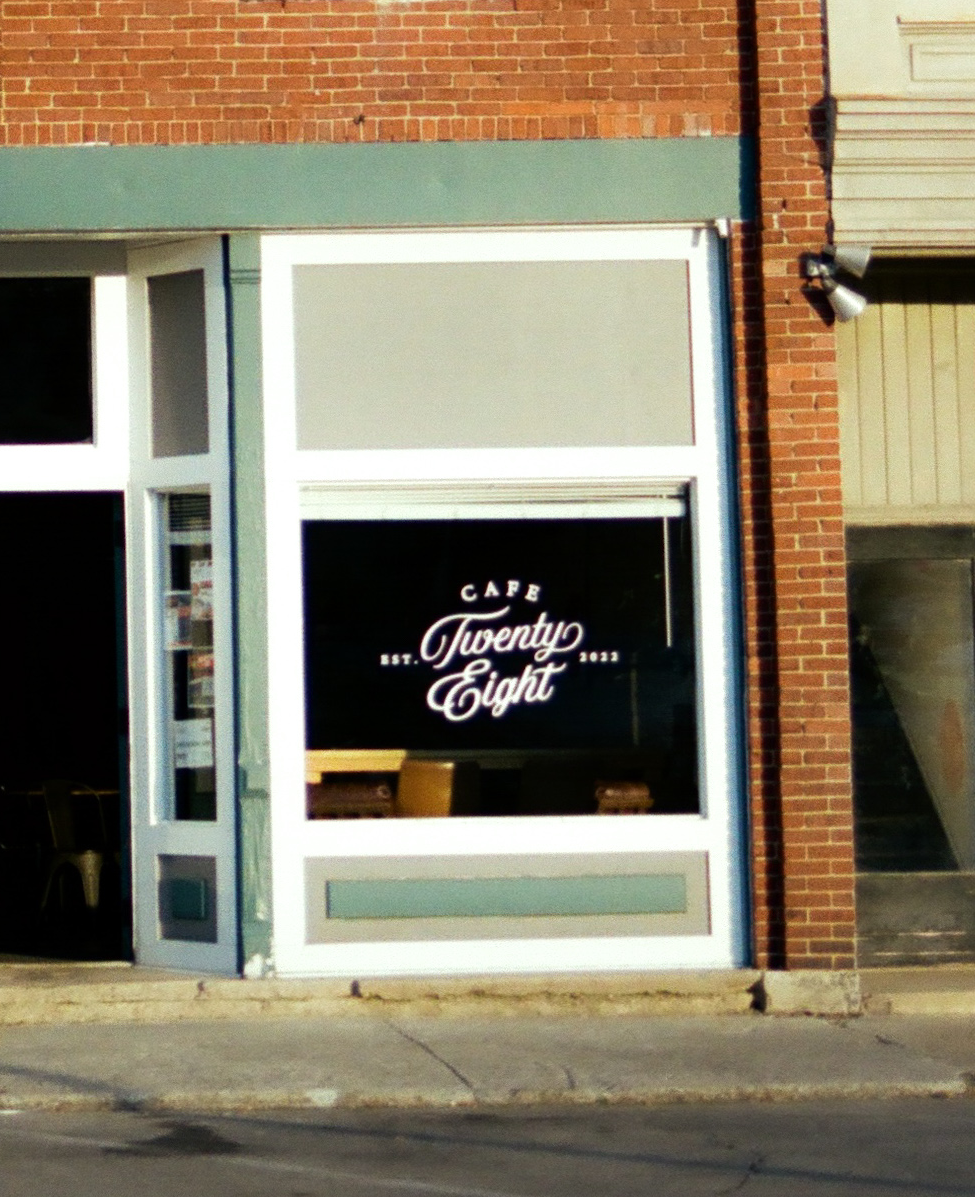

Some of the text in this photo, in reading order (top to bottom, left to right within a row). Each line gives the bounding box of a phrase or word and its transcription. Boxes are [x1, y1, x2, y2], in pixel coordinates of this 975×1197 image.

[460, 580, 541, 602] CAFE
[420, 605, 584, 670] Twenty
[380, 654, 419, 666] EST.
[579, 652, 619, 663] 2022
[427, 658, 567, 722] Eight
